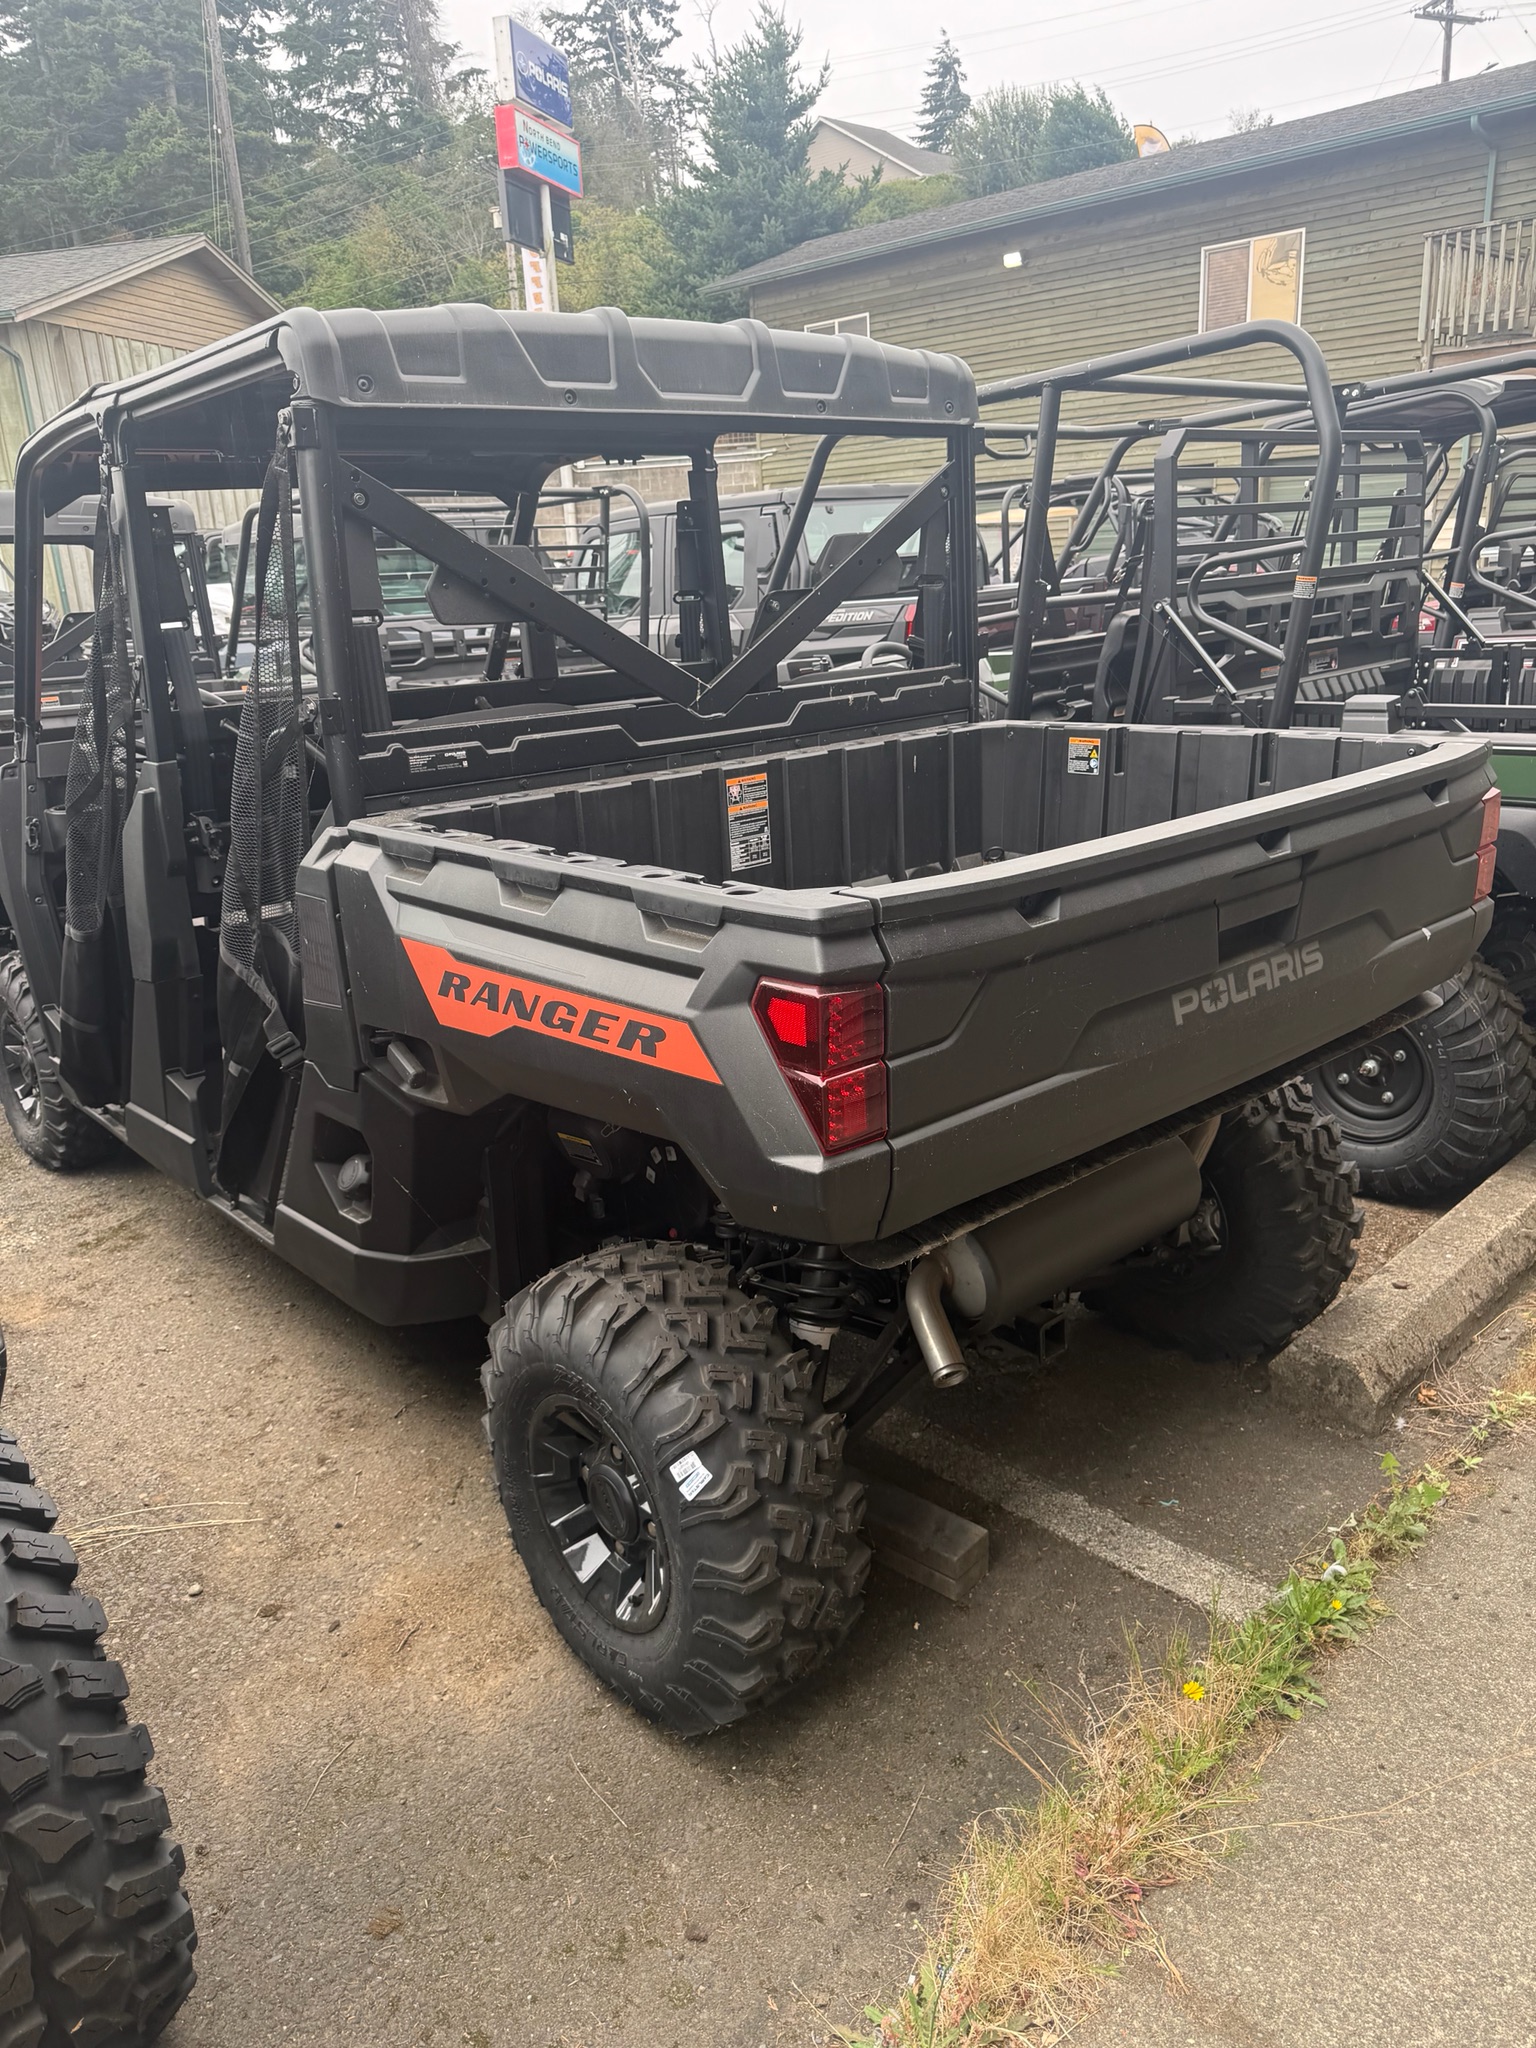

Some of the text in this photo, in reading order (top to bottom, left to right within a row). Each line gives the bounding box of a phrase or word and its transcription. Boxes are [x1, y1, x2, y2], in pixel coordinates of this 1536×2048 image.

[528, 61, 569, 98] POLARIS
[519, 135, 578, 177] POWERSPORTS
[522, 119, 561, 151] NORTH BEND
[1171, 941, 1324, 1026] POLARIS
[437, 970, 667, 1058] RANGER
